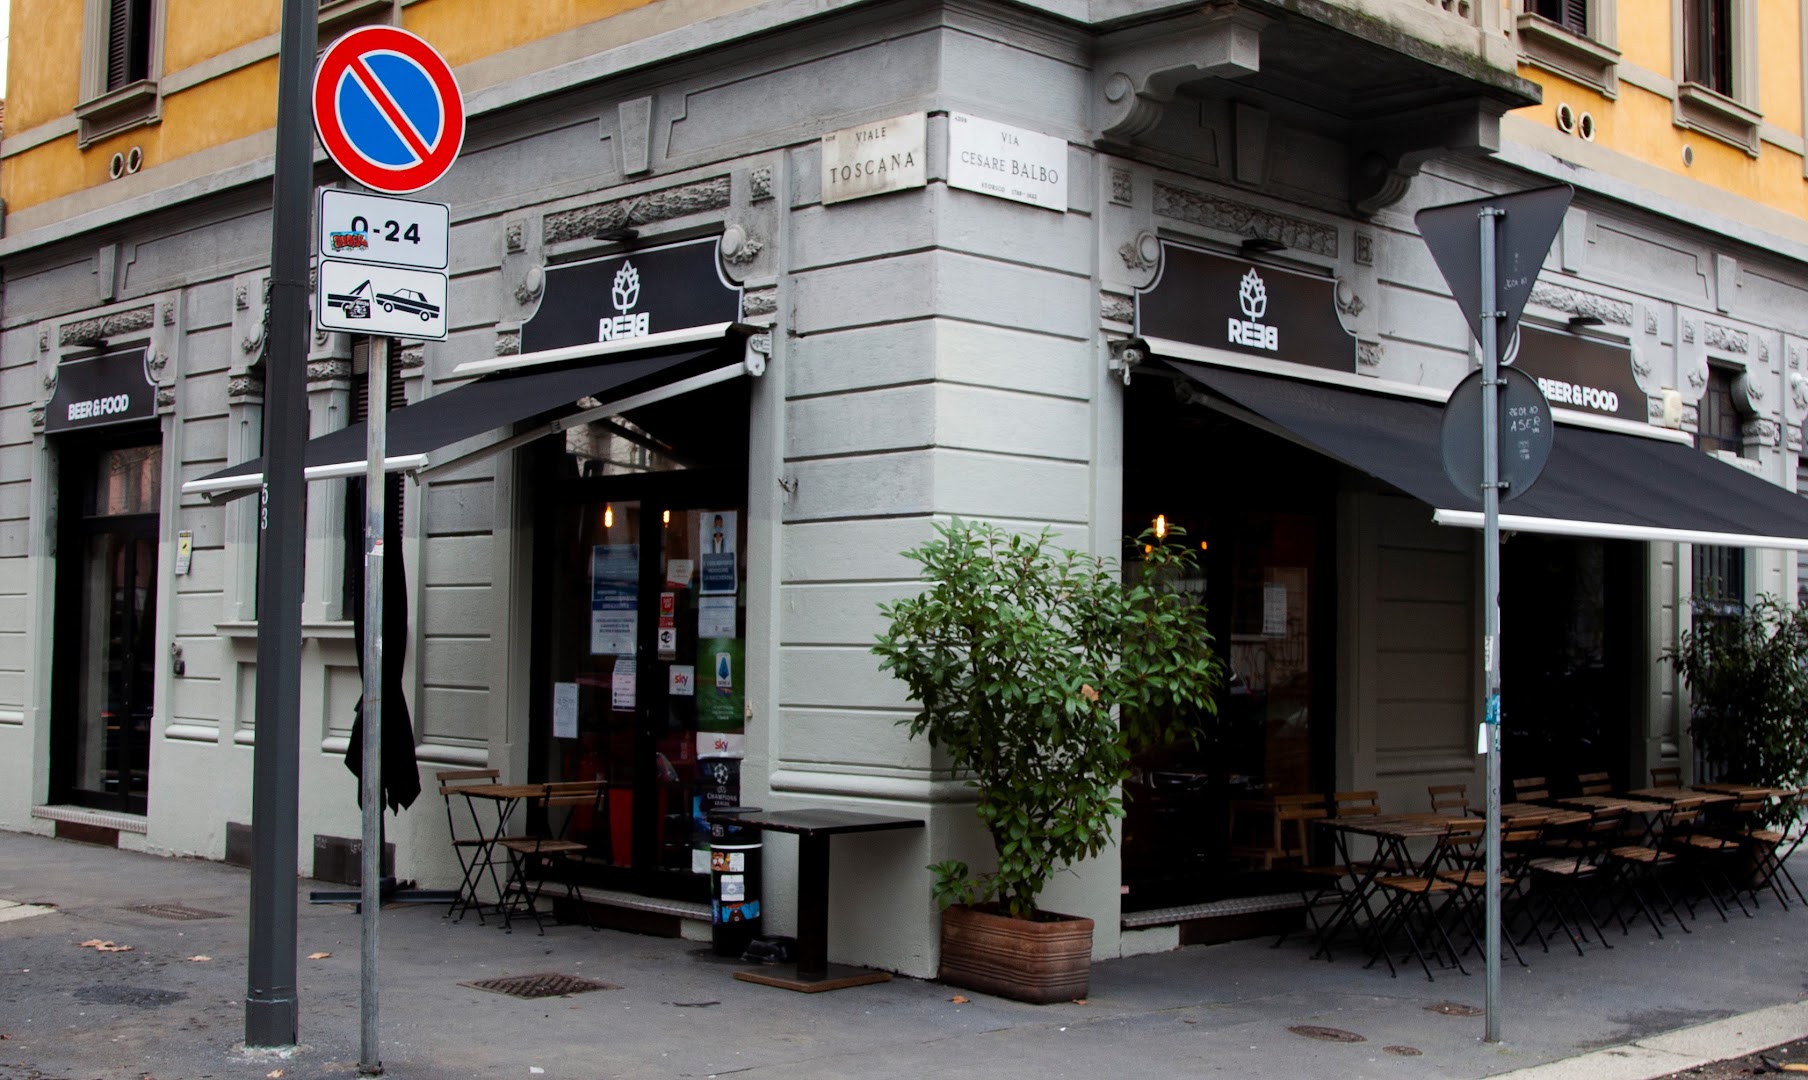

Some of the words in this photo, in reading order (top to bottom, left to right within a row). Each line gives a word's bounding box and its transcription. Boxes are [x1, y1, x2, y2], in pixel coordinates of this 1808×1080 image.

[855, 126, 887, 142] VIALE
[1001, 132, 1020, 147] VIA
[830, 152, 915, 184] TOSCANA
[961, 150, 1005, 172] CESARE
[1011, 159, 1059, 185] BALBO
[598, 311, 650, 343] REEB
[1228, 317, 1278, 351] REEB
[1537, 377, 1619, 413] BEER&FOOD
[67, 393, 130, 421] BEER&FOOD
[1509, 415, 1541, 433] ASER
[674, 673, 688, 687] sky
[714, 738, 728, 752] sky
[706, 792, 738, 802] CHAMPIONS
